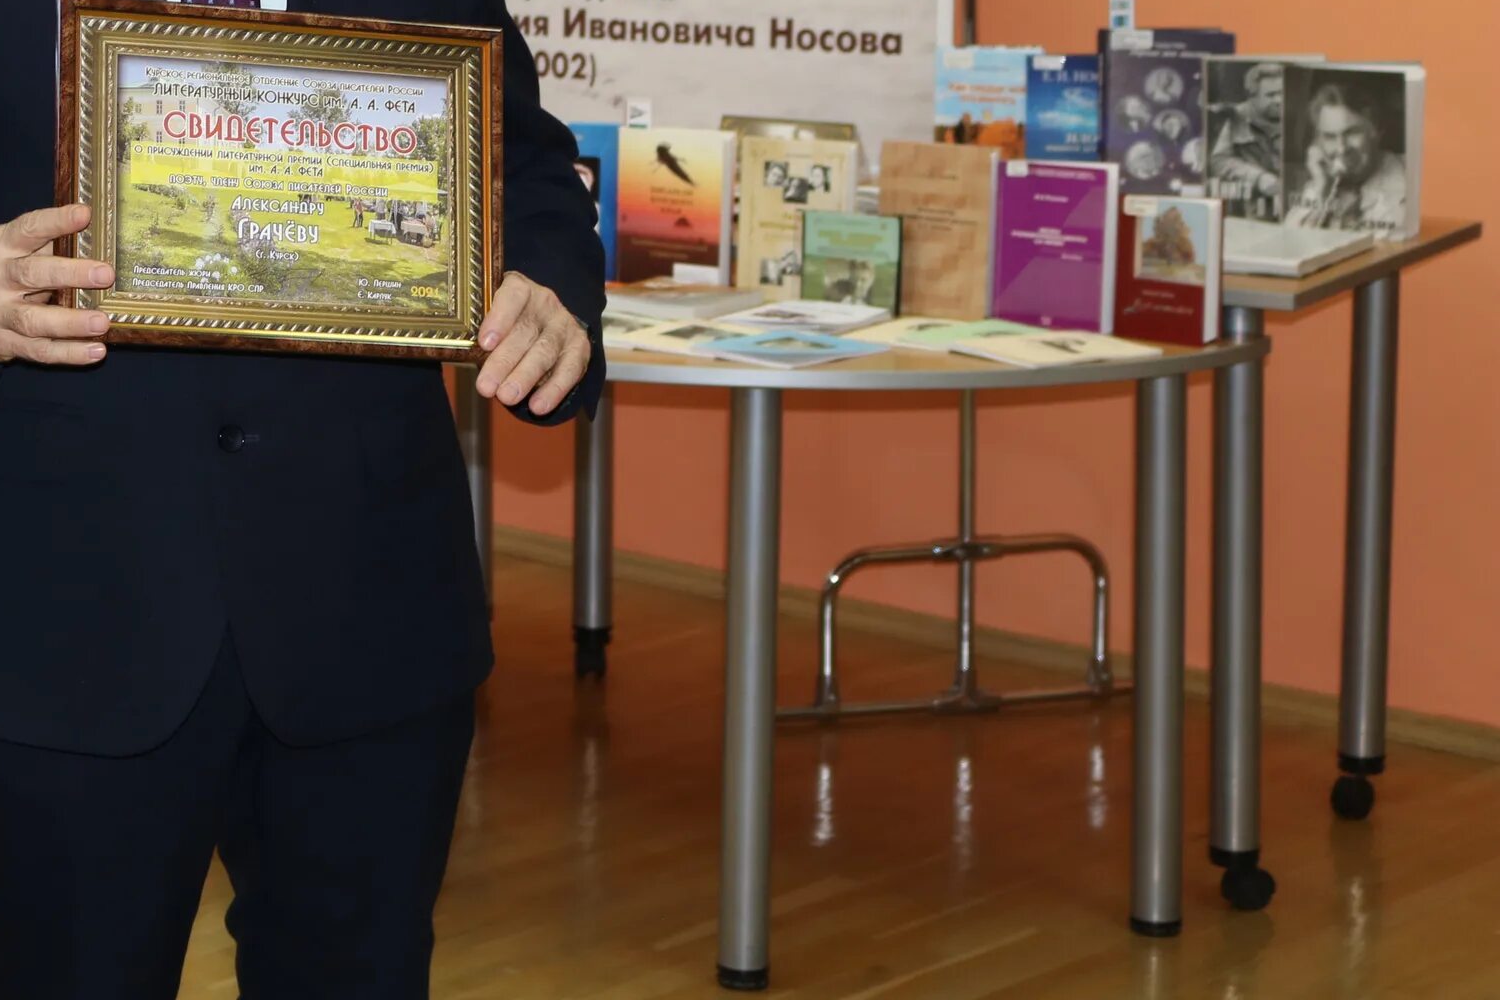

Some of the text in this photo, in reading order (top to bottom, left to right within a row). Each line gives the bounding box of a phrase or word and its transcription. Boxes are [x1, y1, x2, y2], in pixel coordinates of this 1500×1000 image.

[563, 7, 755, 48] Ивановича
[769, 17, 903, 56] Носова
[163, 110, 417, 155] СВИДЕТЕЛЬСТВО
